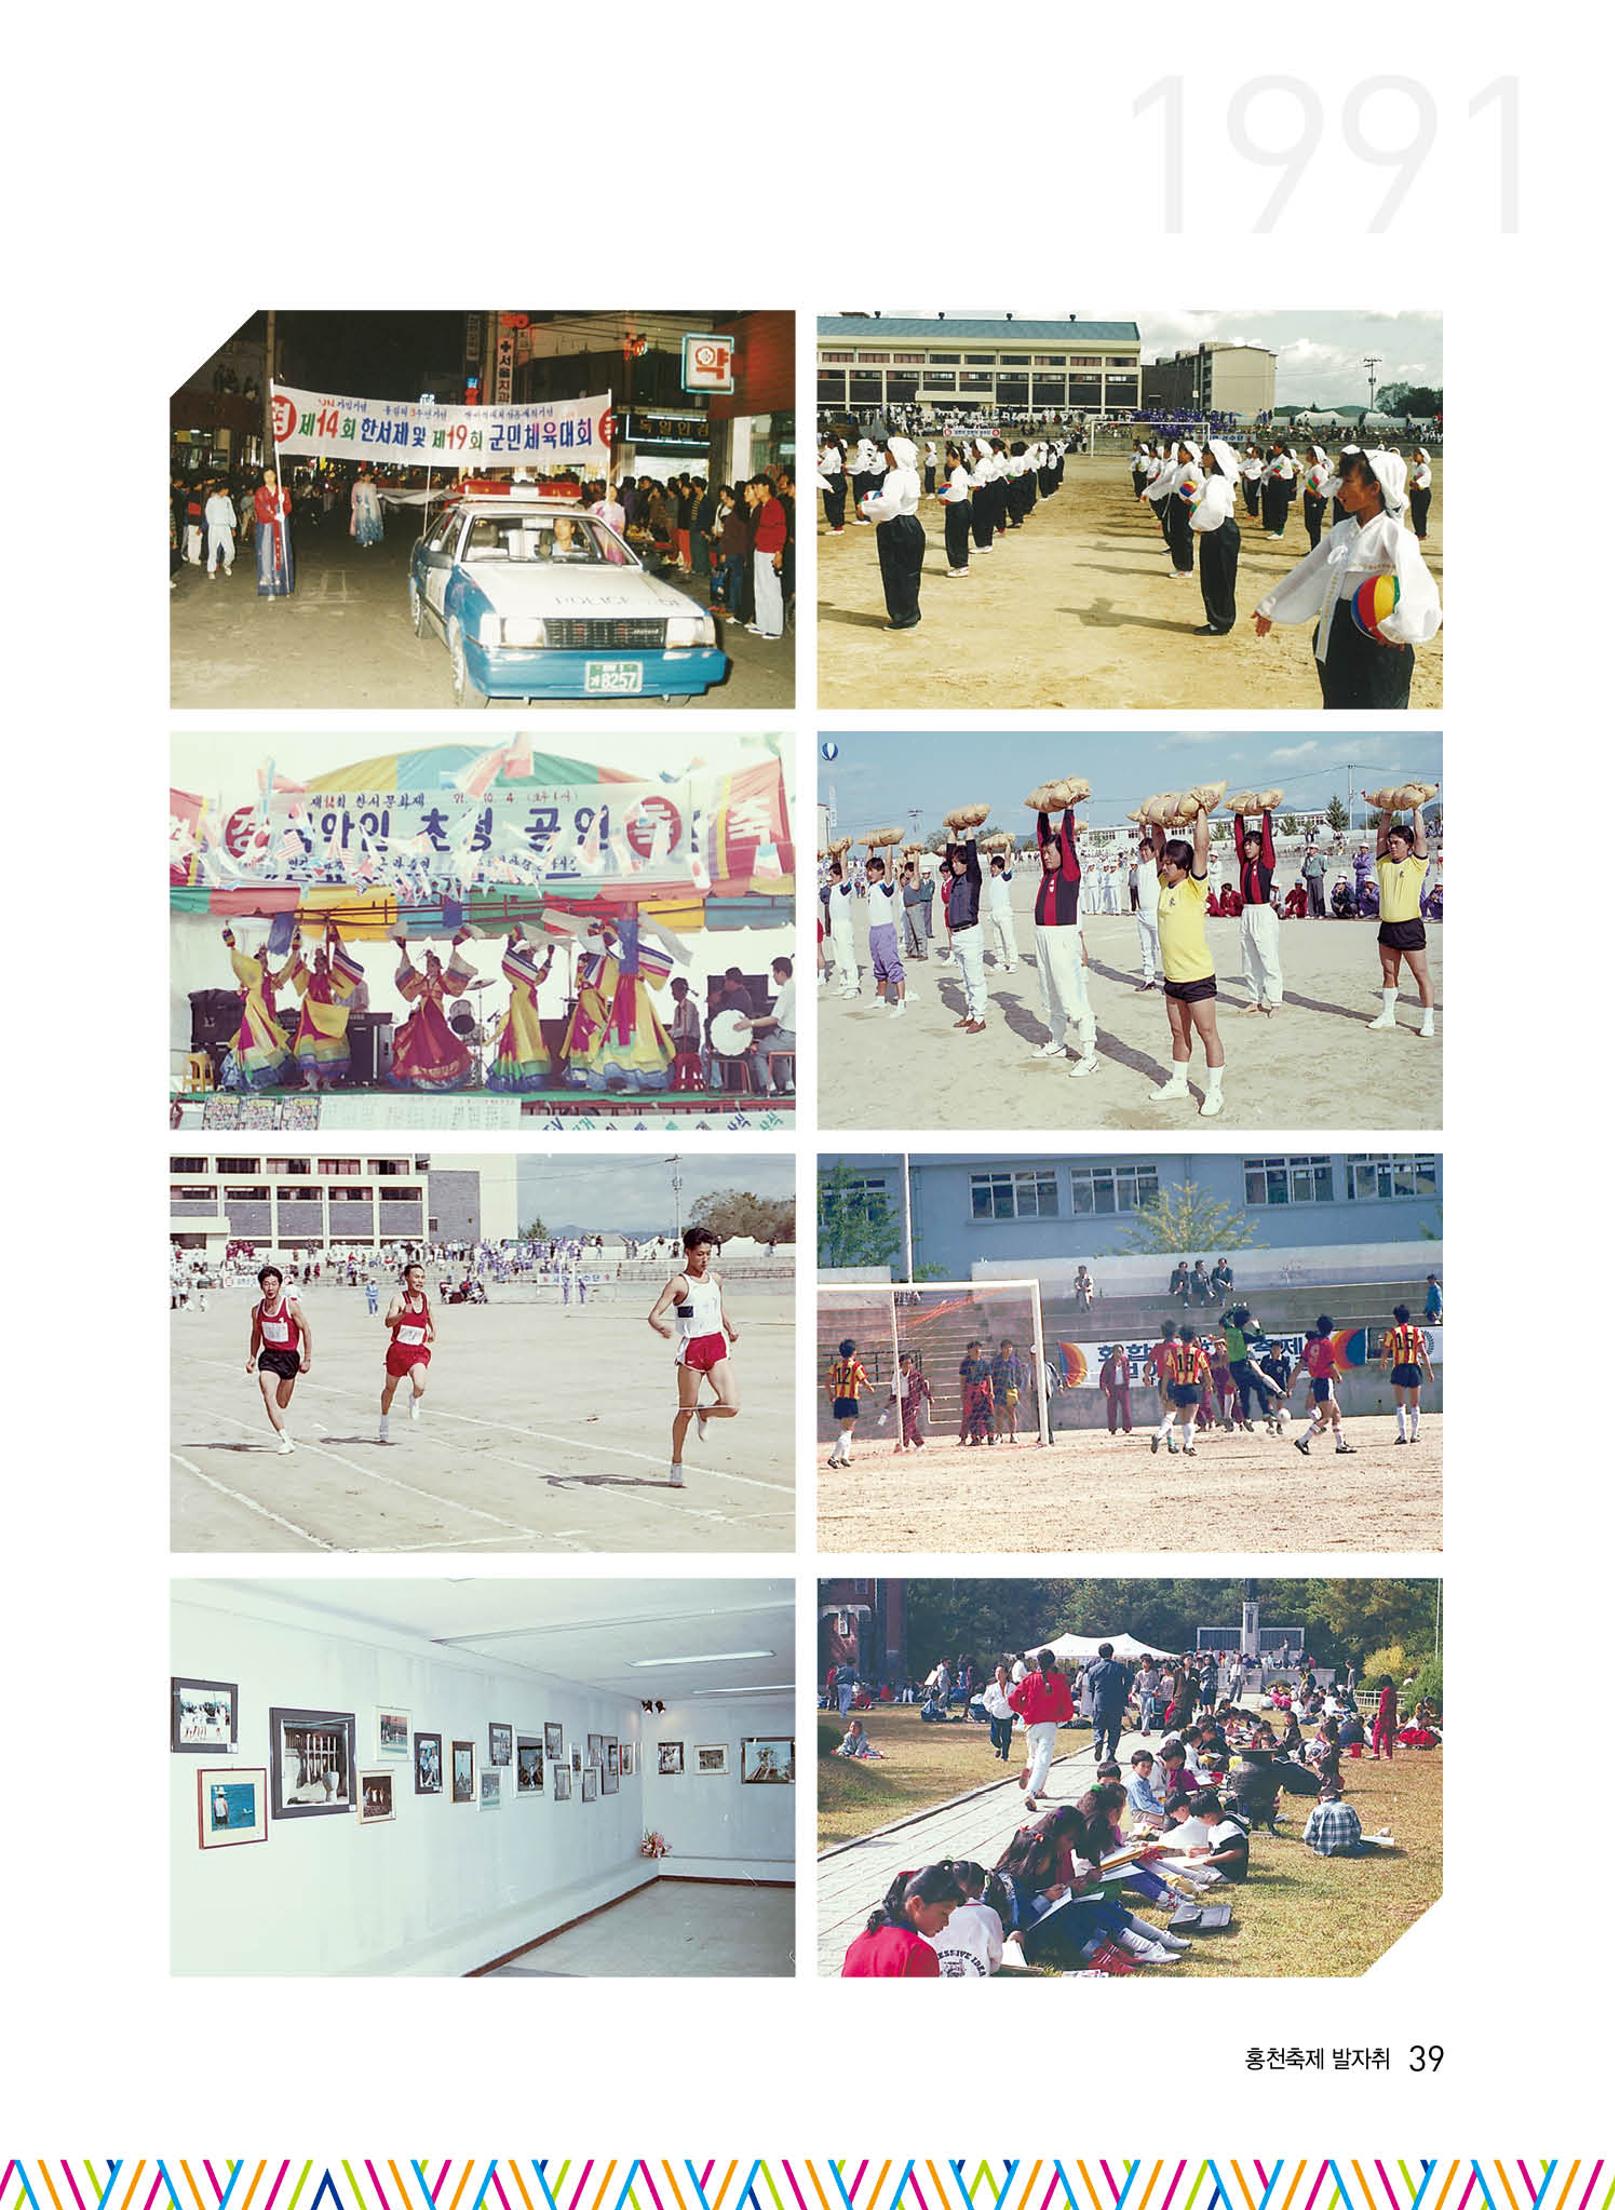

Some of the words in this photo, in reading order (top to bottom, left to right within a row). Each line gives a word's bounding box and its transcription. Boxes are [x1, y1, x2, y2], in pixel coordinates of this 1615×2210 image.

[695, 346, 729, 379] 약
[298, 409, 357, 441] 제14회
[361, 416, 409, 447] 한서제
[412, 425, 426, 448] 및
[432, 423, 483, 451] 제19회
[489, 417, 592, 451] 군민체육대회
[524, 804, 609, 851] 공연
[836, 1367, 851, 1385] 12
